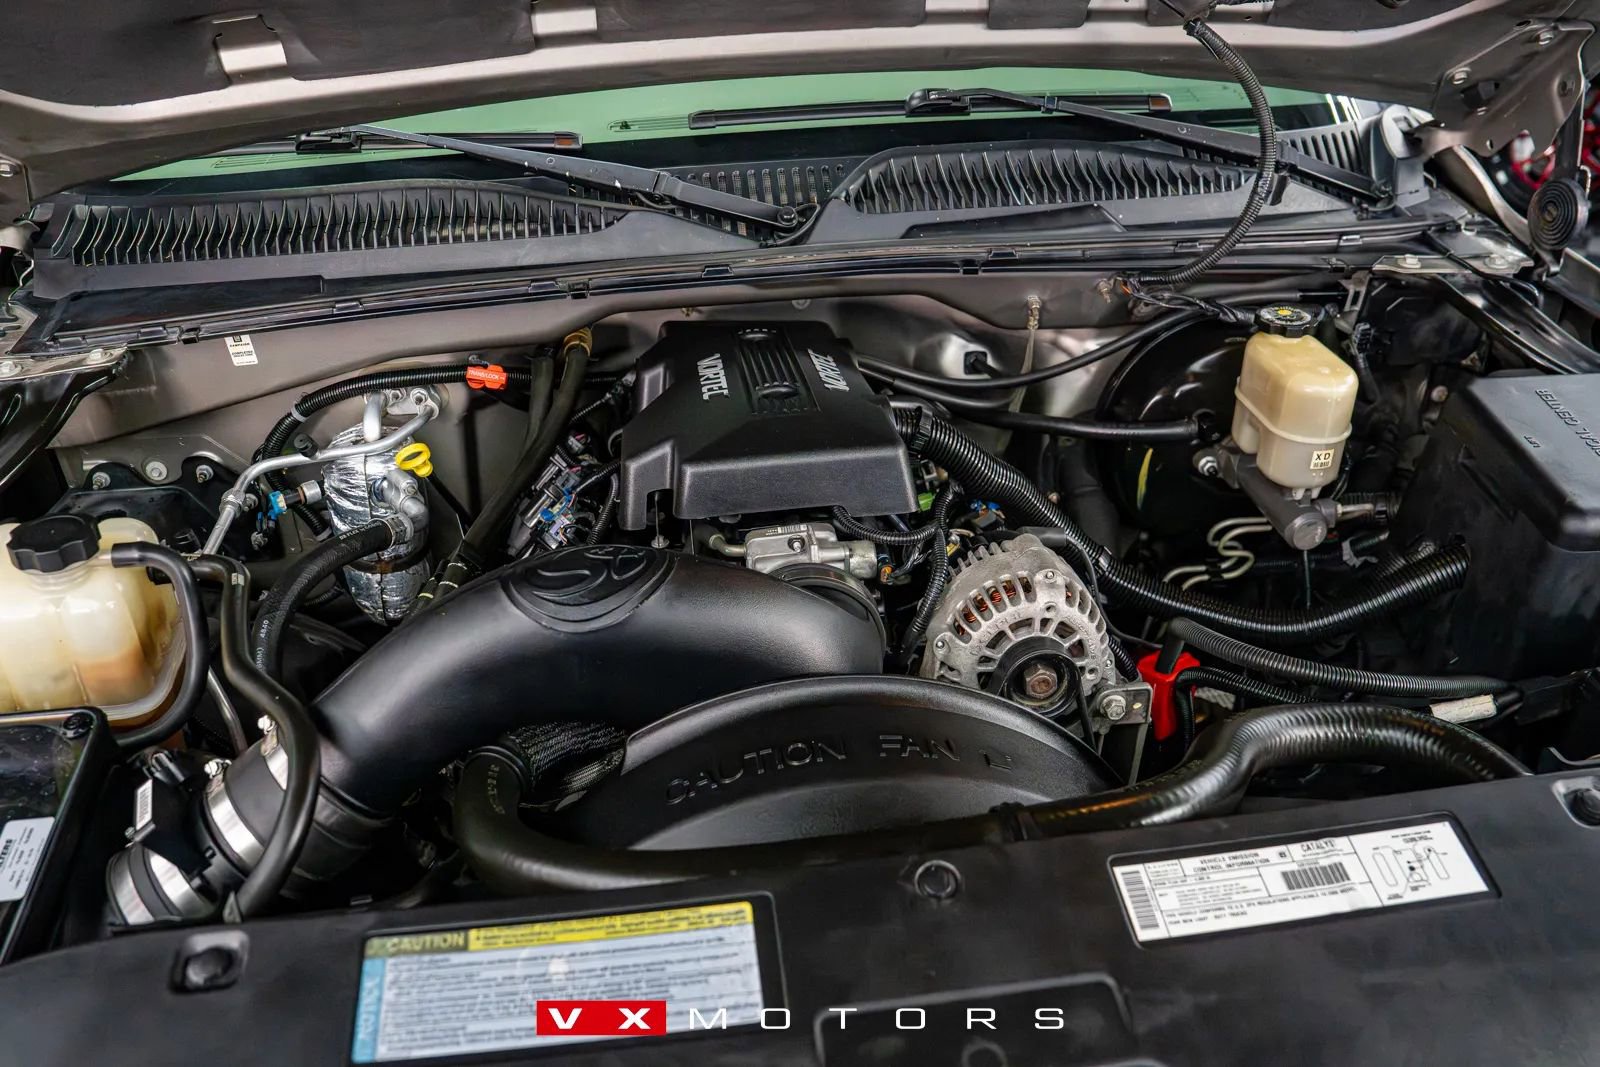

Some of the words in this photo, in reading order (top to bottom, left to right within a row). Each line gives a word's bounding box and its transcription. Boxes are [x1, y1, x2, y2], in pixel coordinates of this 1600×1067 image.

[697, 353, 731, 401] VORTEC
[666, 739, 848, 806] CAUTION
[879, 734, 961, 762] FAN
[386, 932, 465, 952] CAUTION
